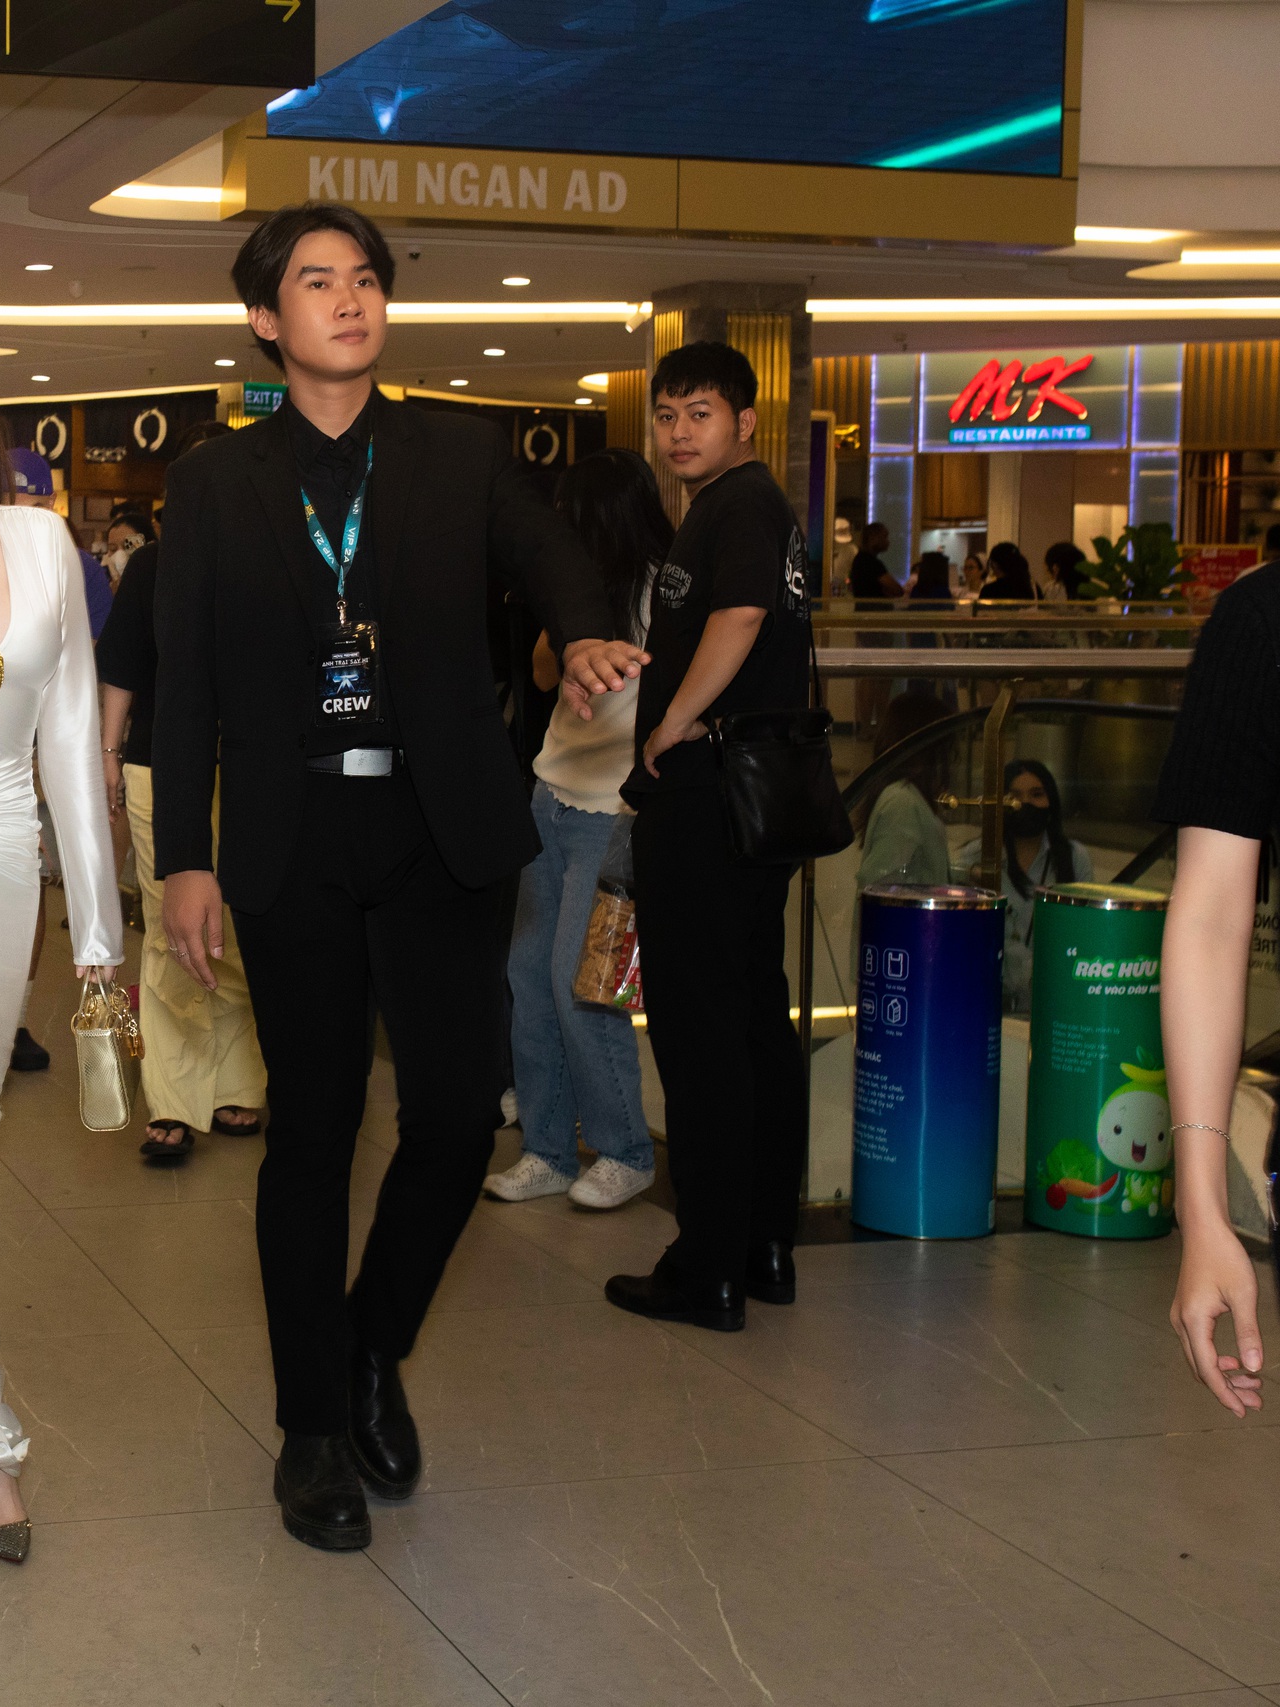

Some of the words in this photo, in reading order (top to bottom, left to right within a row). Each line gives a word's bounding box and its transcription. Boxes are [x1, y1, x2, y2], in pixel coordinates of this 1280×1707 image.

[308, 156, 399, 203] KIM
[416, 161, 548, 210] NGAN
[563, 169, 628, 213] AD
[245, 390, 271, 404] EXIT
[948, 354, 1094, 423] MK
[953, 426, 1087, 442] RESTAURANTS
[348, 527, 357, 546] VIP
[323, 547, 335, 564] VIP
[323, 696, 371, 714] CREW
[1075, 958, 1115, 978] RÁC
